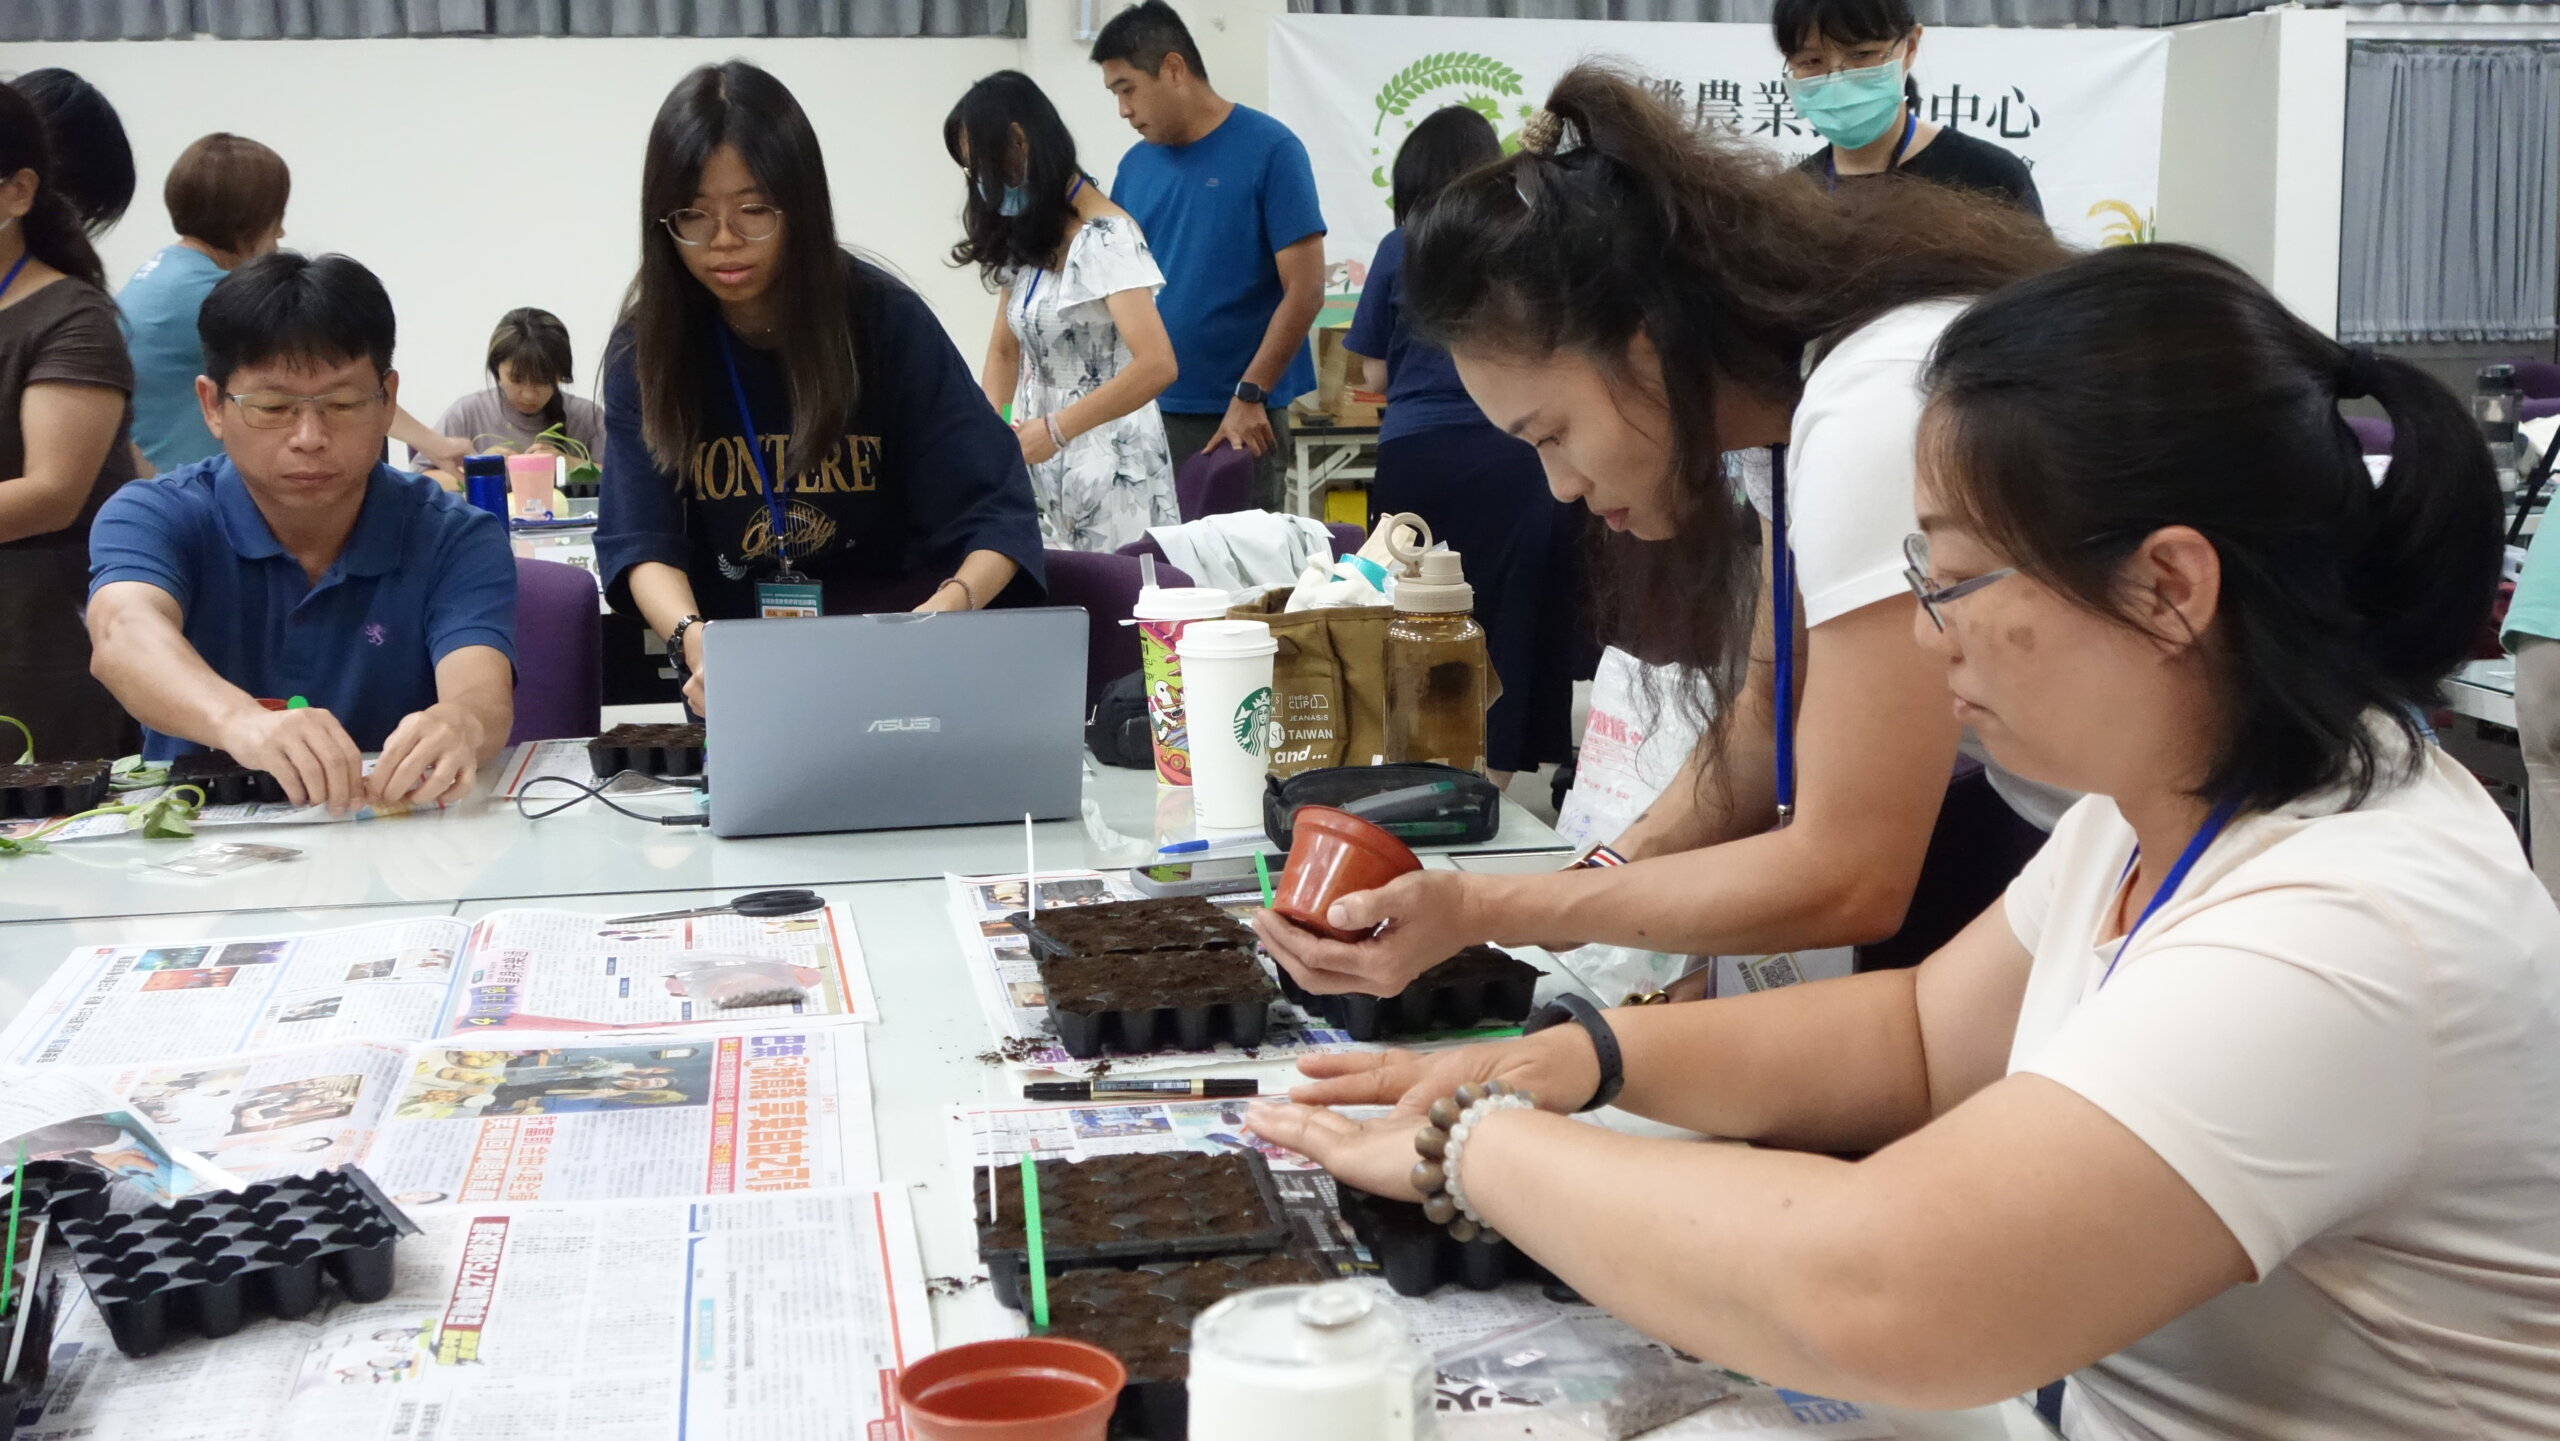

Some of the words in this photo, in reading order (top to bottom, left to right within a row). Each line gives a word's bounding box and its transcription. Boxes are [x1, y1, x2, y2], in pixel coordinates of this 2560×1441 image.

[1639, 79, 2041, 139] 農業中心
[1289, 700, 1310, 710] CLIP
[866, 717, 931, 733] ASUS
[1288, 729, 1333, 740] TAIWAN
[1275, 745, 1311, 764] and
